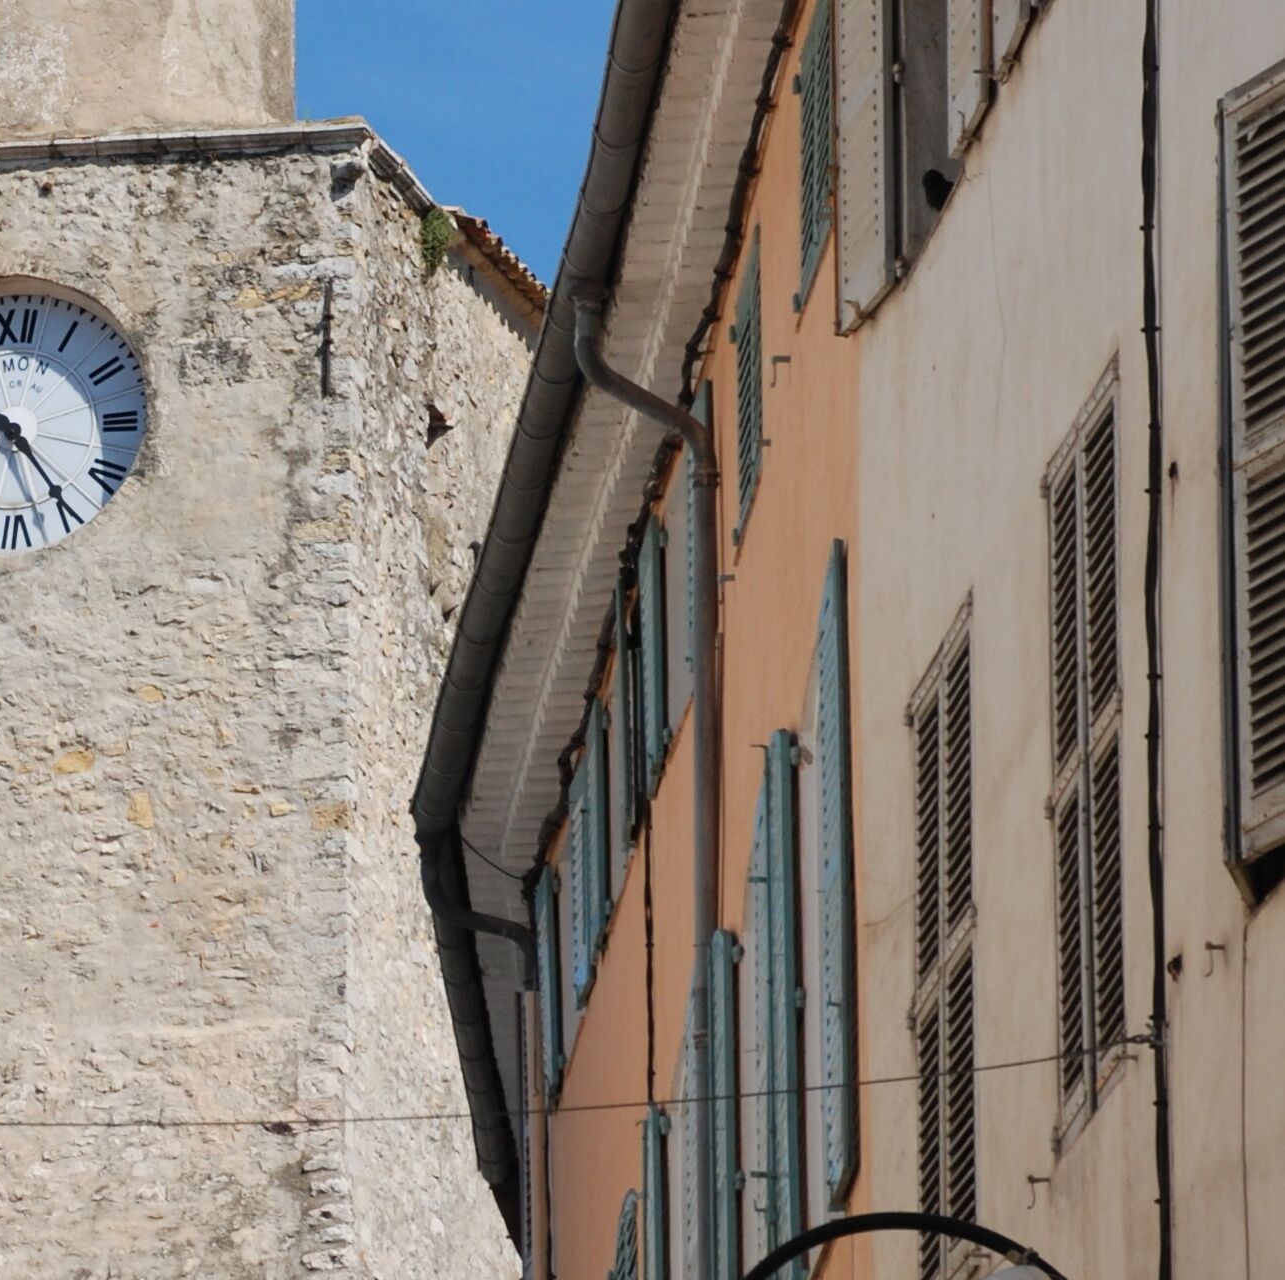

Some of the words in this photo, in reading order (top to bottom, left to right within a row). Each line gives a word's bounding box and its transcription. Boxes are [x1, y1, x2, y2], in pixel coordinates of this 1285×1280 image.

[58, 321, 79, 352] I
[89, 356, 125, 385] II
[102, 410, 138, 432] III
[88, 458, 127, 495] IV
[1, 515, 32, 549] VI
[55, 499, 85, 533] V
